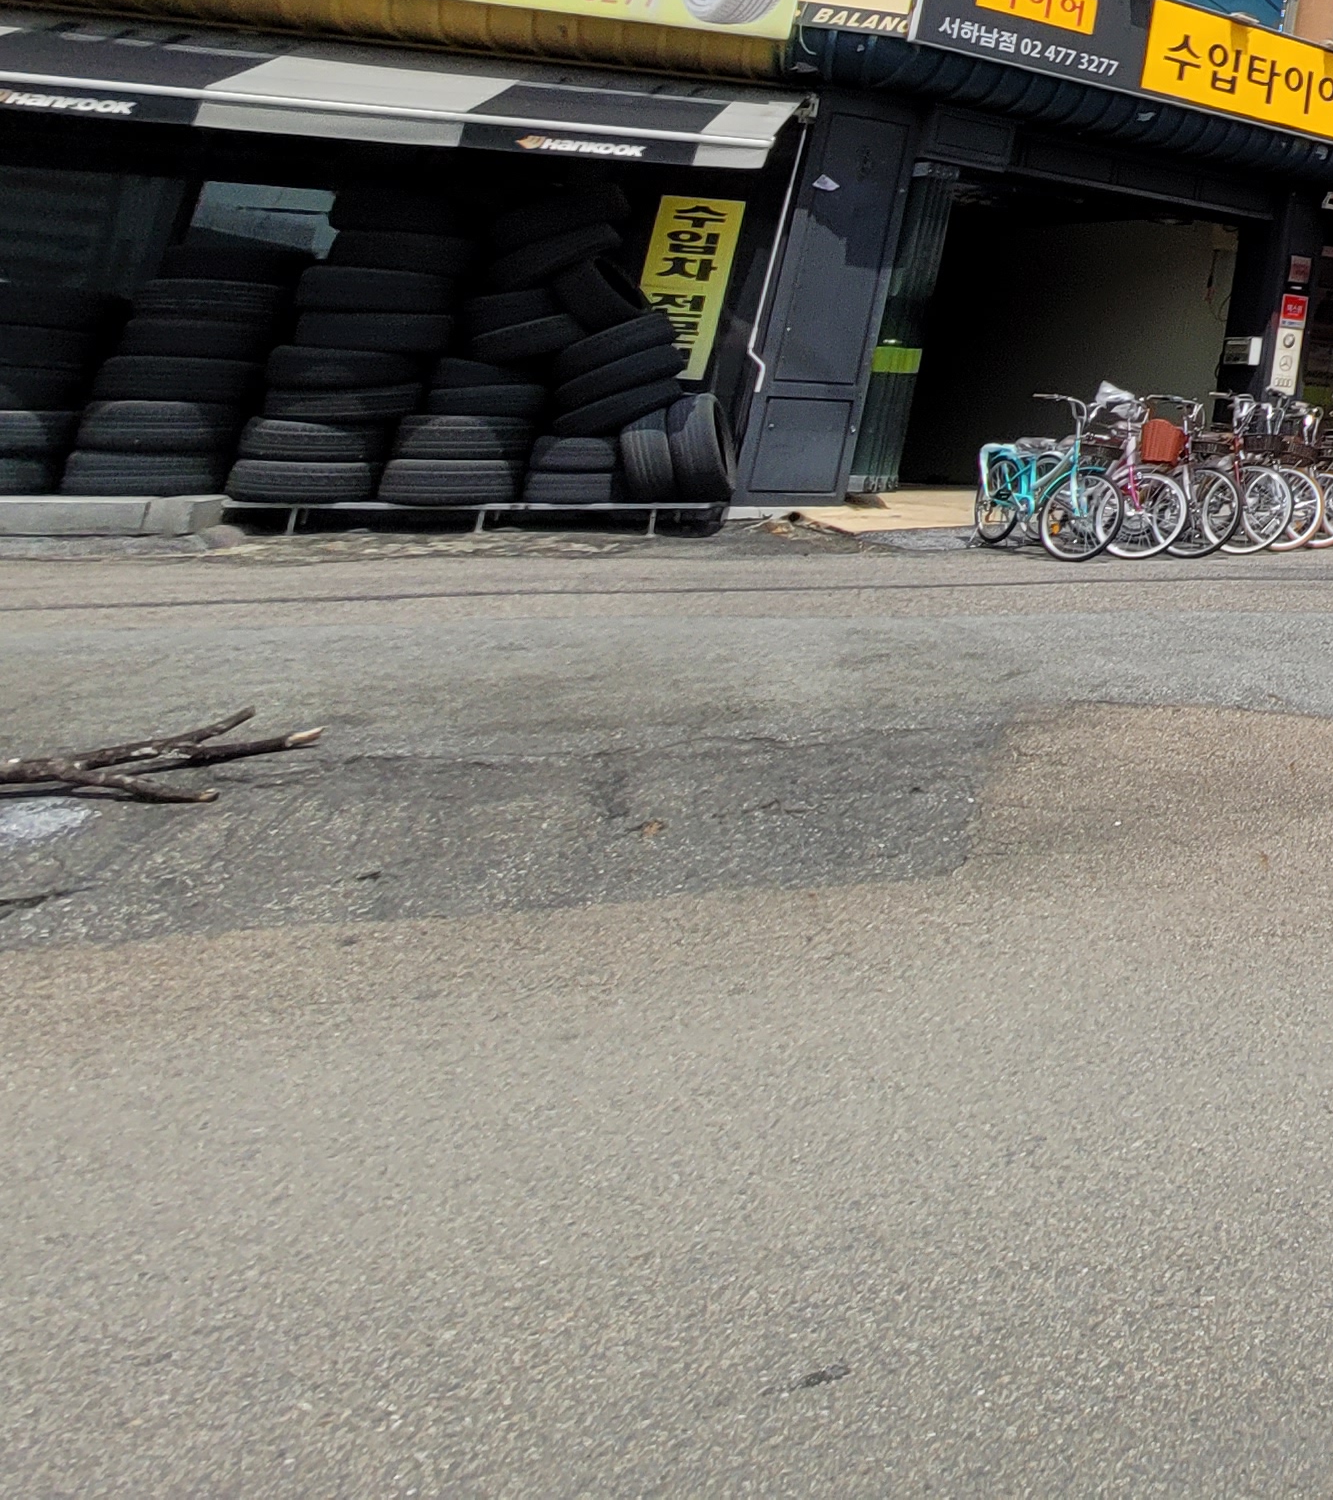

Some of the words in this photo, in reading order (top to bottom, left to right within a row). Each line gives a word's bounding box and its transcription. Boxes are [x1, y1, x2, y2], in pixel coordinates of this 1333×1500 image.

[938, 16, 1016, 54] 서하남점
[1020, 36, 1041, 58] 02
[1044, 43, 1077, 68] 477
[1080, 52, 1118, 77] 3277
[656, 204, 728, 282] 수입차
